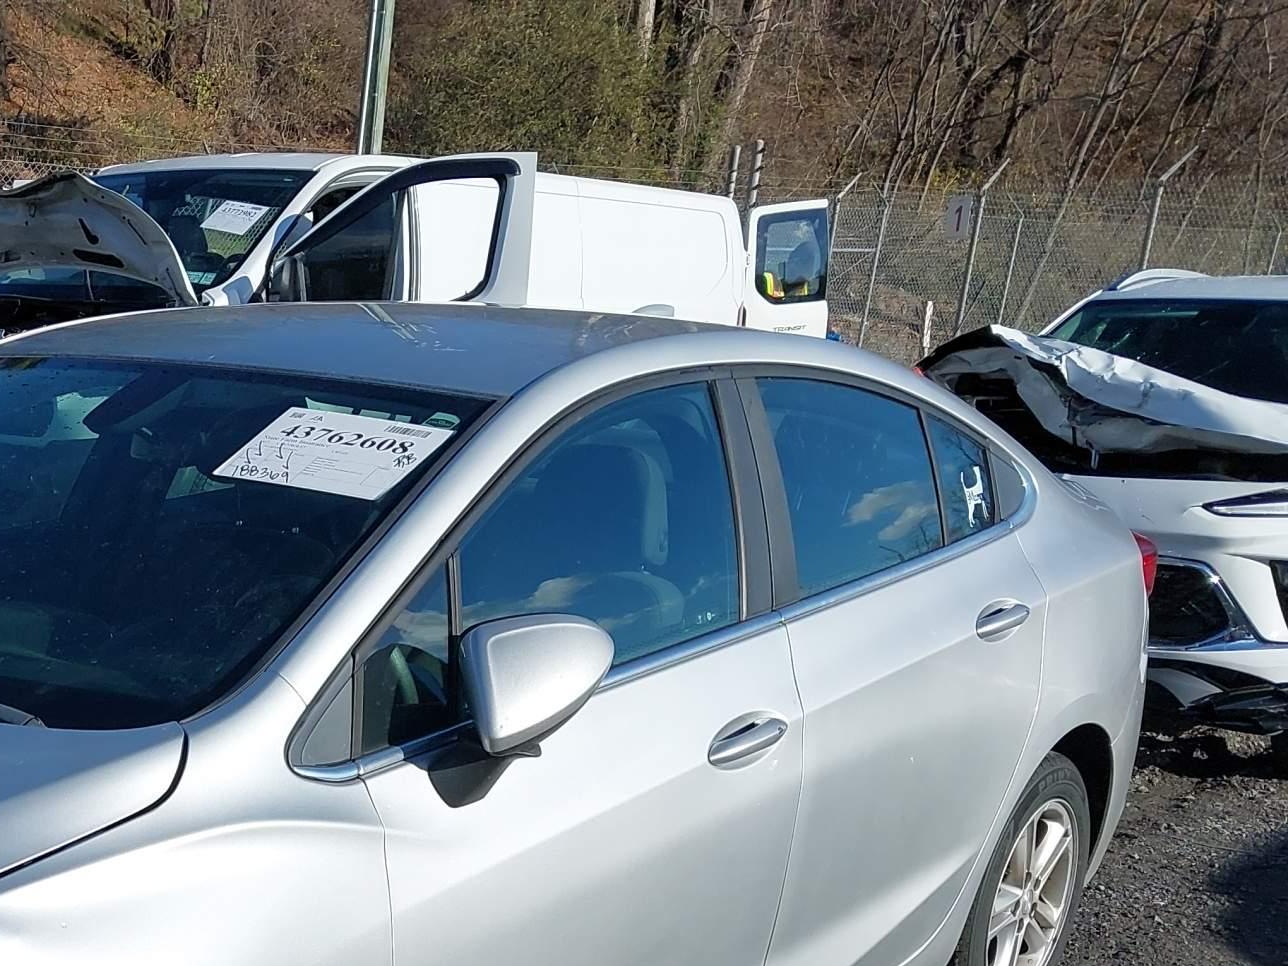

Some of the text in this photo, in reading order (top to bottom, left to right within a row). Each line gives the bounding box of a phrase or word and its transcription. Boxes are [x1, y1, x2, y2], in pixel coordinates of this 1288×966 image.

[954, 205, 963, 232] 1
[773, 324, 808, 333] TRANSIT
[280, 425, 415, 454] 43762608
